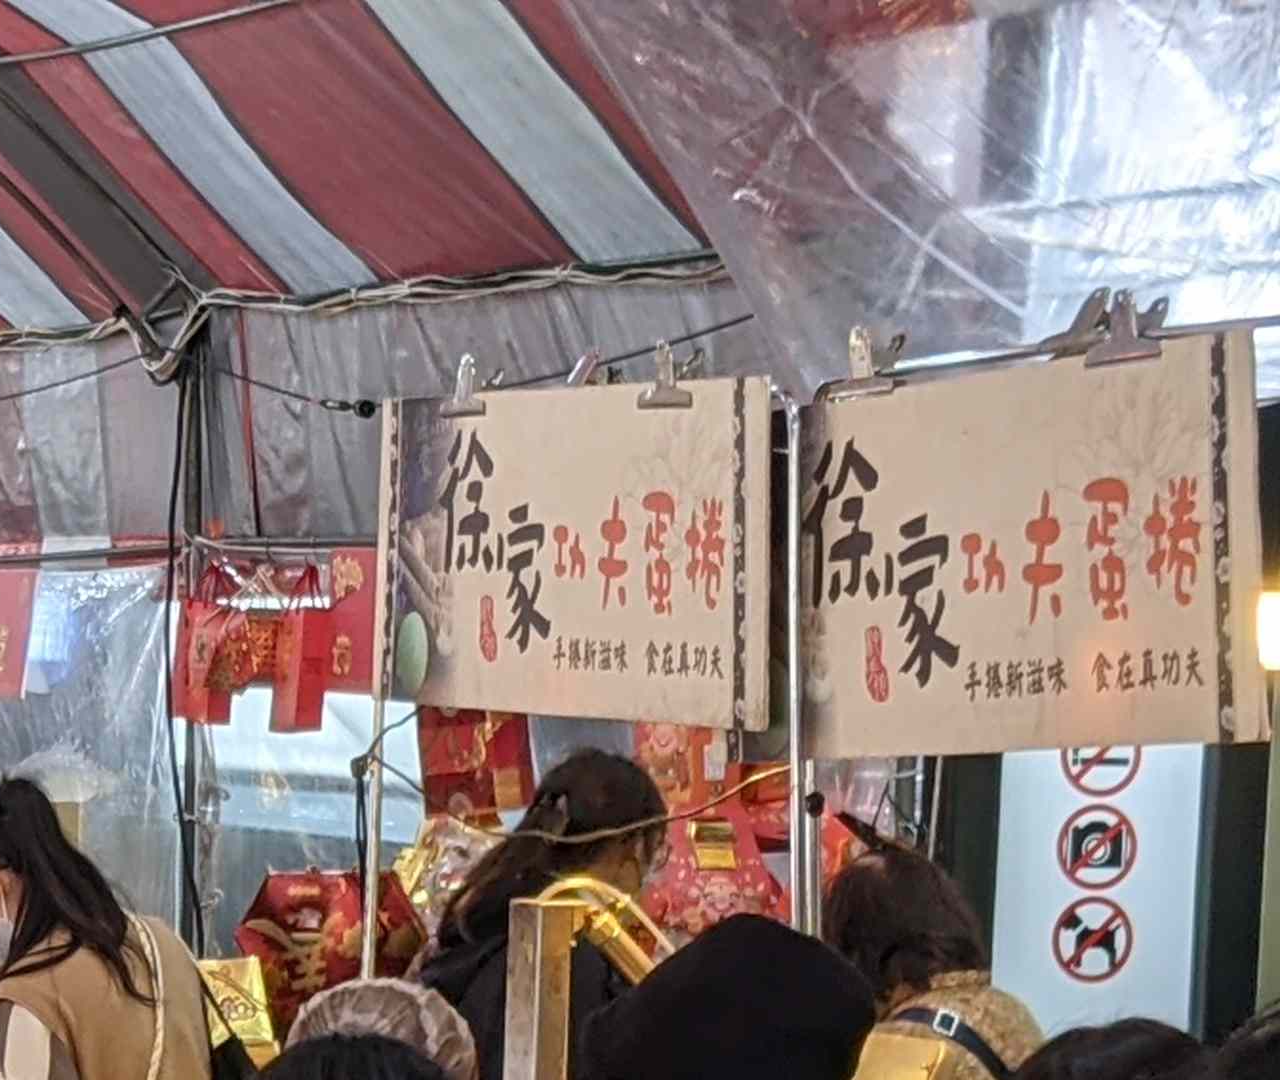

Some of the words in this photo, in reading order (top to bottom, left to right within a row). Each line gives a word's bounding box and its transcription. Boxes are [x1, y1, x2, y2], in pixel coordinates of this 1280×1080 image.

[553, 636, 628, 673] 手捲新滋味
[645, 641, 725, 679] 食在真功夫
[963, 658, 1068, 700] 手捲新滋味
[1091, 645, 1205, 694] 食在真功夫
